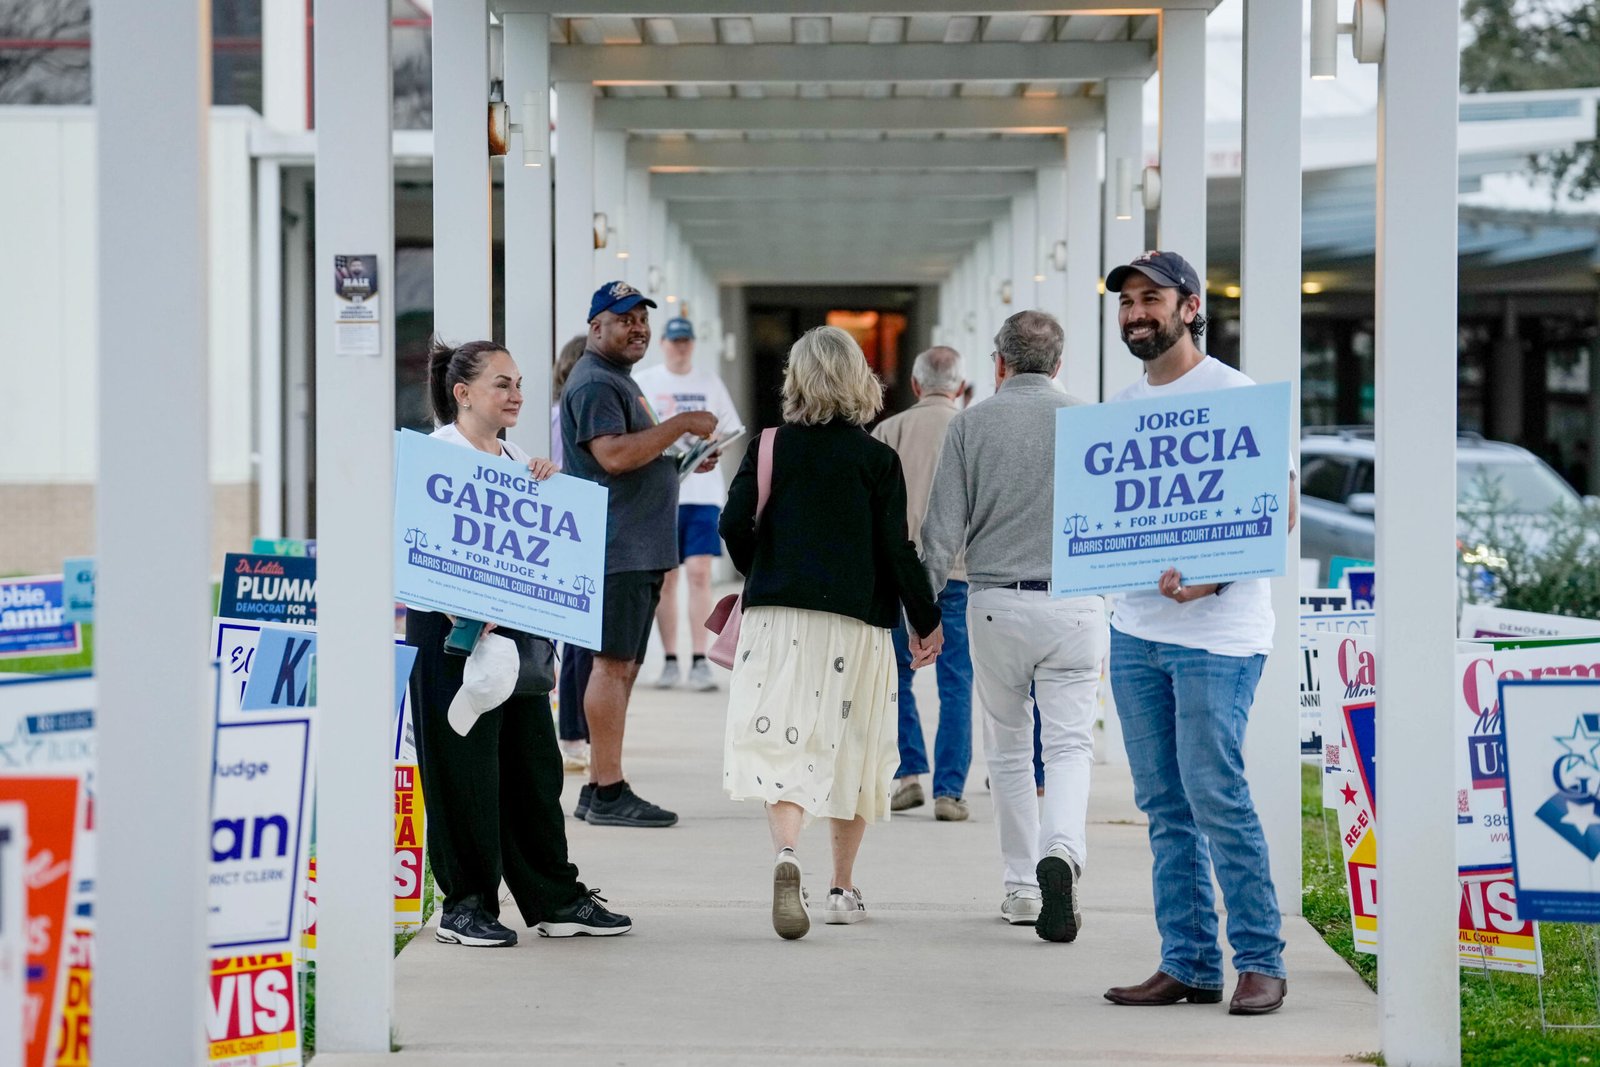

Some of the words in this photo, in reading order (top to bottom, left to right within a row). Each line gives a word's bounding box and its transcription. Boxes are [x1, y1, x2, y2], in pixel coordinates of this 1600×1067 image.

[1135, 408, 1210, 433] JORGE
[1084, 425, 1261, 476] GARCIA
[472, 465, 540, 497] JORGE
[1114, 469, 1224, 513] DIAZ
[426, 473, 582, 543] GARCIA
[1130, 516, 1157, 528] FOR
[1161, 510, 1208, 525] JUDGE
[452, 513, 550, 568] DIAZ
[1072, 539, 1103, 555] HARRIS
[1104, 535, 1139, 552] COUNTY
[1139, 531, 1181, 547] CRIMINAL
[1181, 526, 1211, 543] COURT
[1211, 525, 1223, 539] AT
[1224, 522, 1244, 539] LAW
[1245, 522, 1260, 536] NO.
[1262, 521, 1269, 535] 7
[235, 559, 252, 573] Dr.
[466, 551, 490, 567] FOR
[493, 559, 536, 578] JUDGE
[236, 575, 317, 602] PLUMM
[411, 552, 441, 571] HARRIS
[441, 560, 474, 579] COUNTY
[473, 568, 511, 591] CRIMINAL
[511, 577, 538, 597] COURT
[537, 586, 548, 600] AT
[549, 589, 567, 605] LAW
[567, 595, 581, 609] NO.
[581, 599, 588, 610] 7
[235, 602, 286, 614] DEMOCRAT
[287, 604, 306, 615] FOR
[1499, 623, 1560, 637] DEMOCRAT
[1473, 932, 1500, 945] Court
